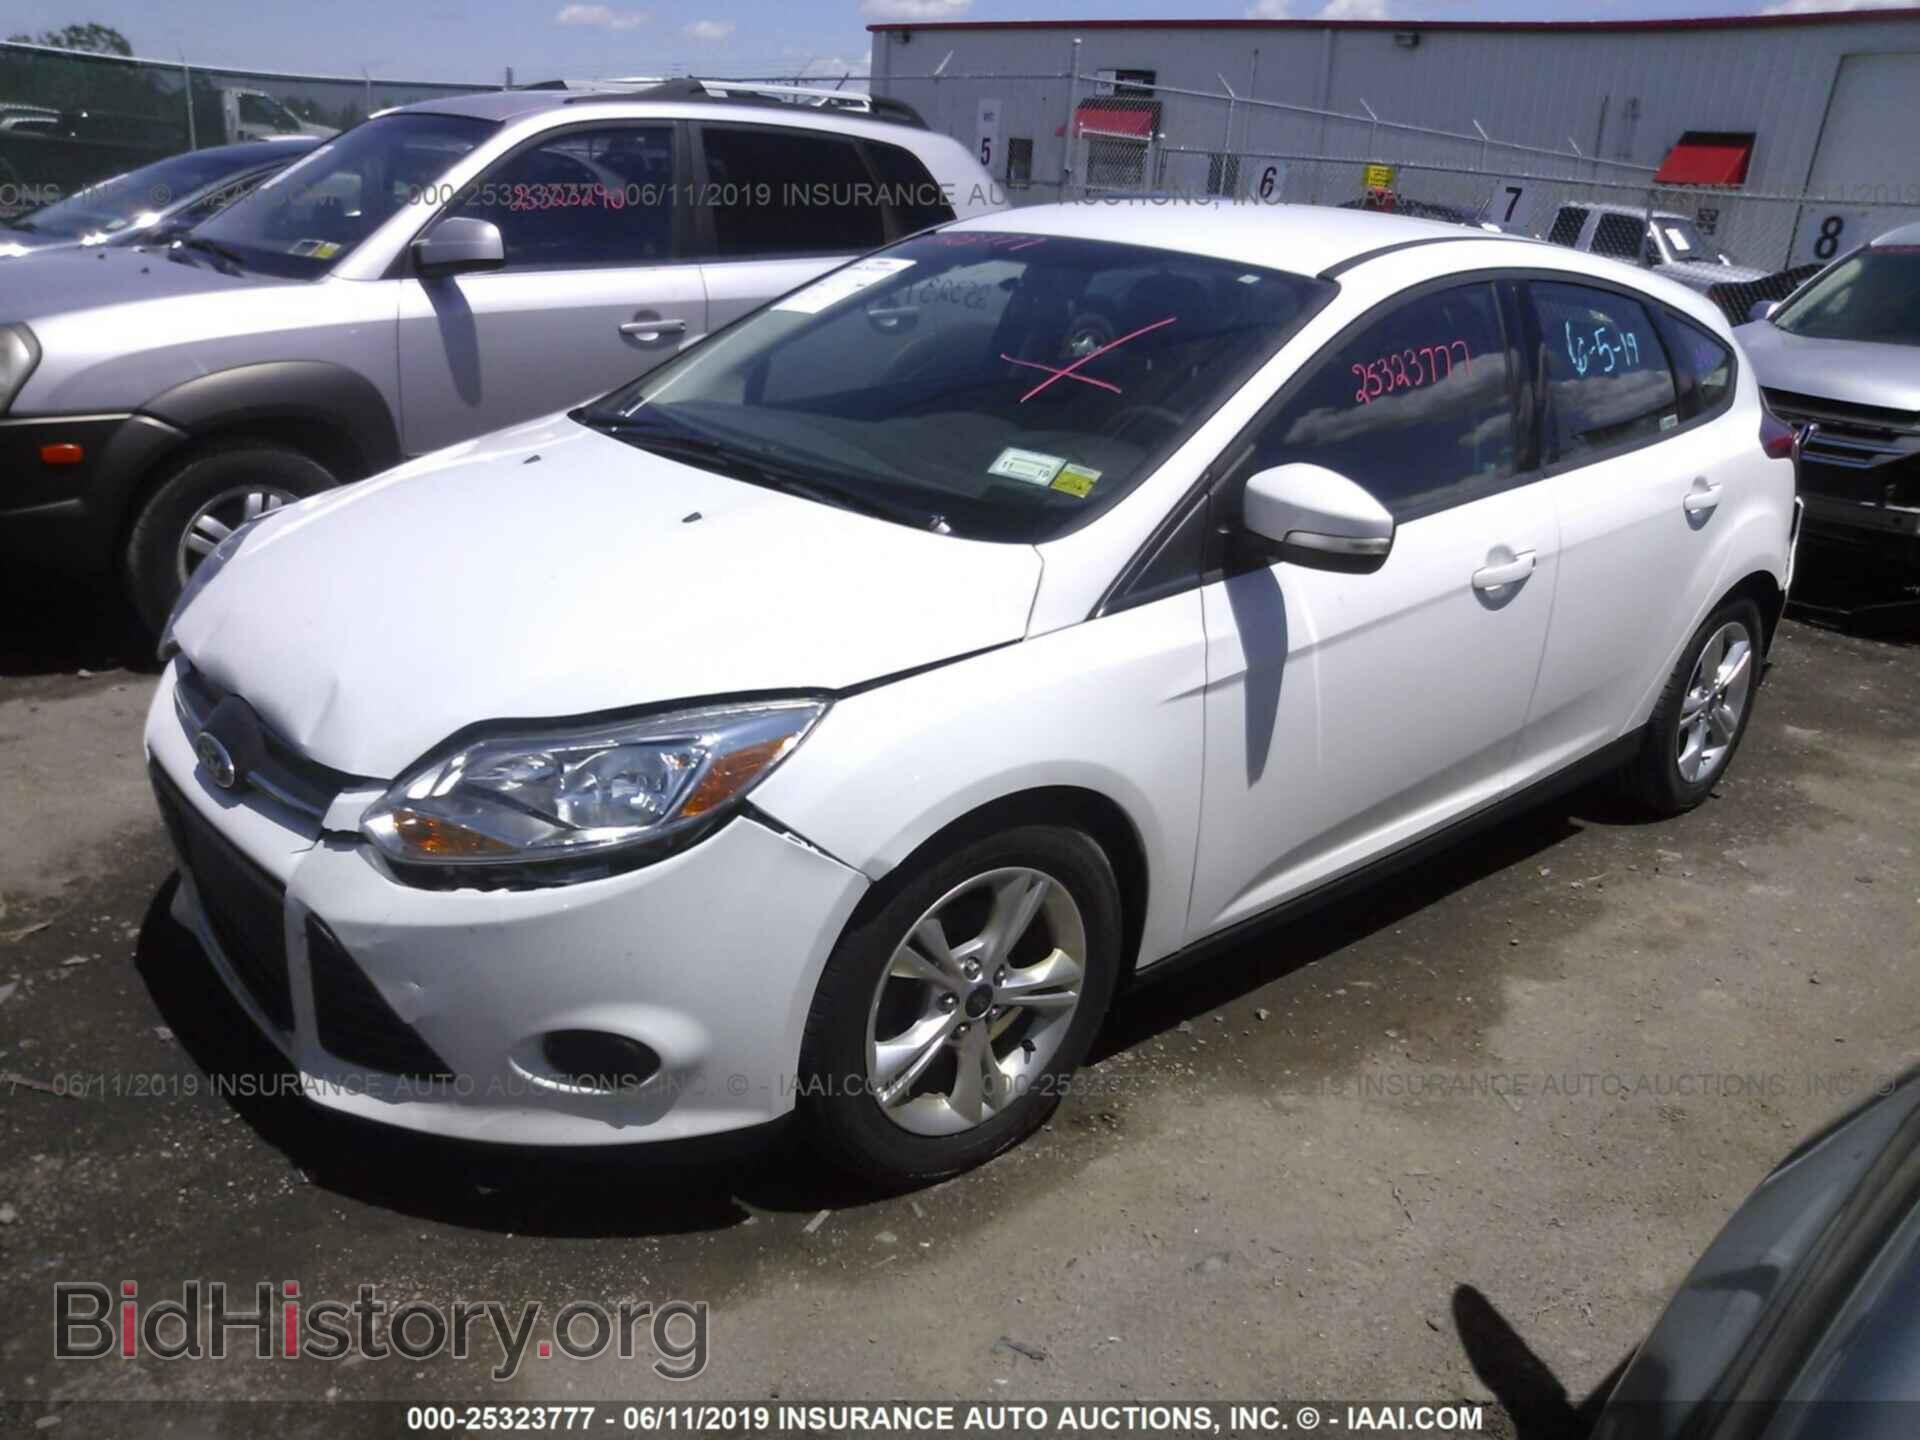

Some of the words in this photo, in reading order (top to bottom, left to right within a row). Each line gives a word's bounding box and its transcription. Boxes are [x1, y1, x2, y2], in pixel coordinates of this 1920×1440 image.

[980, 136, 992, 167] 5
[1258, 165, 1279, 199] 6
[1504, 186, 1523, 223] 7
[1814, 215, 1844, 260] 8
[1351, 340, 1472, 405] 25323777
